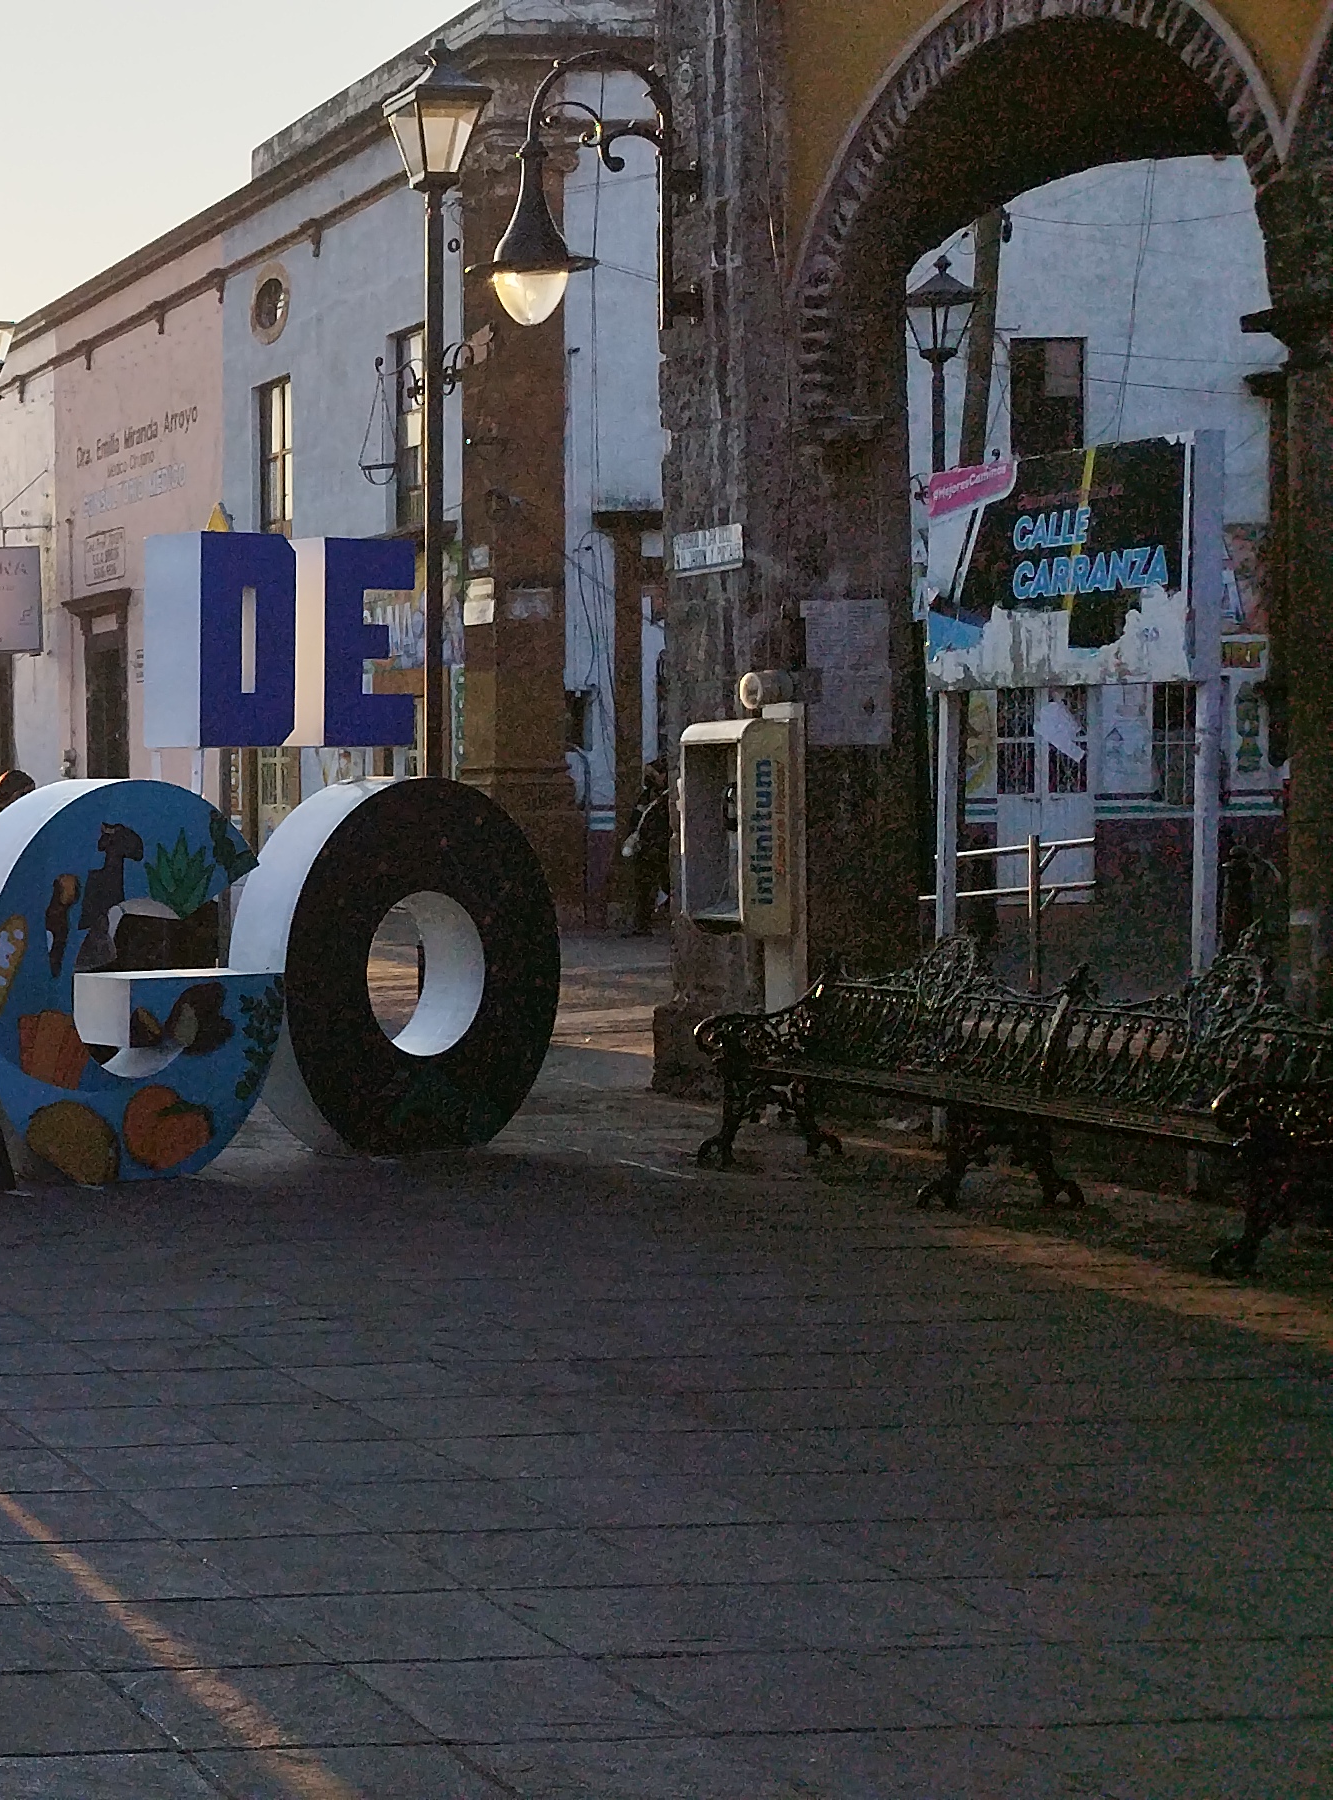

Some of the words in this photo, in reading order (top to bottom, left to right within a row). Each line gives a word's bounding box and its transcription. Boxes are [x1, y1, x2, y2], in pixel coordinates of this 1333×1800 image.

[163, 405, 199, 434] Arroyo
[1013, 505, 1090, 550] CALLE
[1012, 544, 1169, 600] CARRANZA
[144, 531, 415, 748] DE
[750, 758, 774, 905] infinitum
